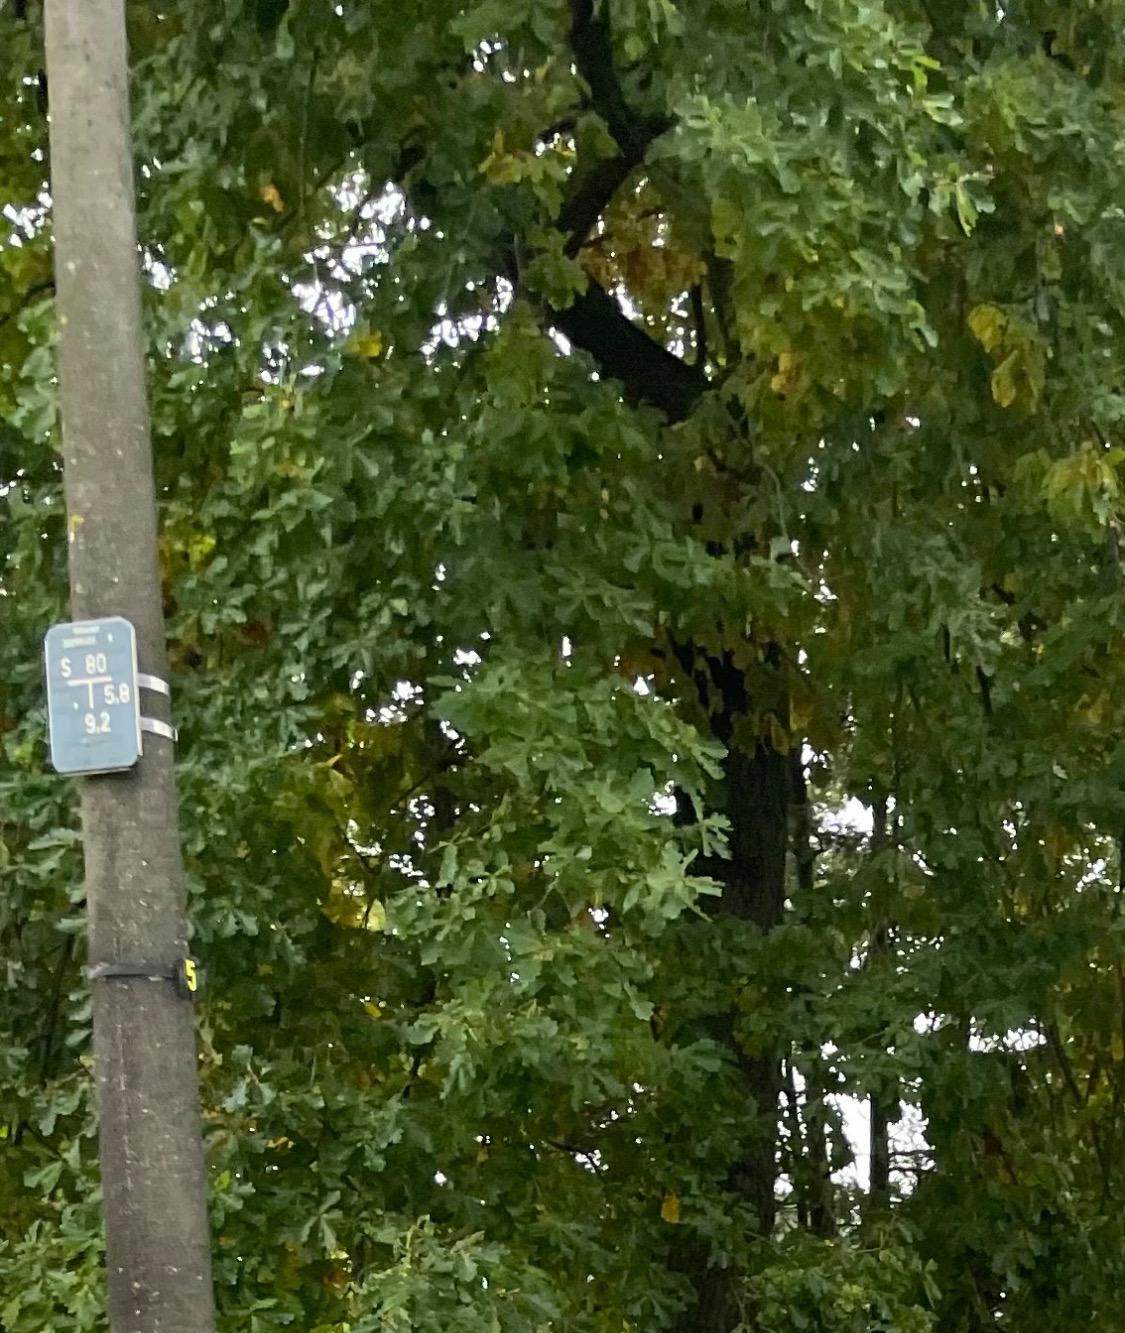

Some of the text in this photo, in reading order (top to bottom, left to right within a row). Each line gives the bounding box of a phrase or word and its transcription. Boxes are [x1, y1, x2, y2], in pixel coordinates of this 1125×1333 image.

[61, 653, 106, 677] S 80
[104, 683, 130, 705] 5.8
[84, 712, 111, 734] 9.2
